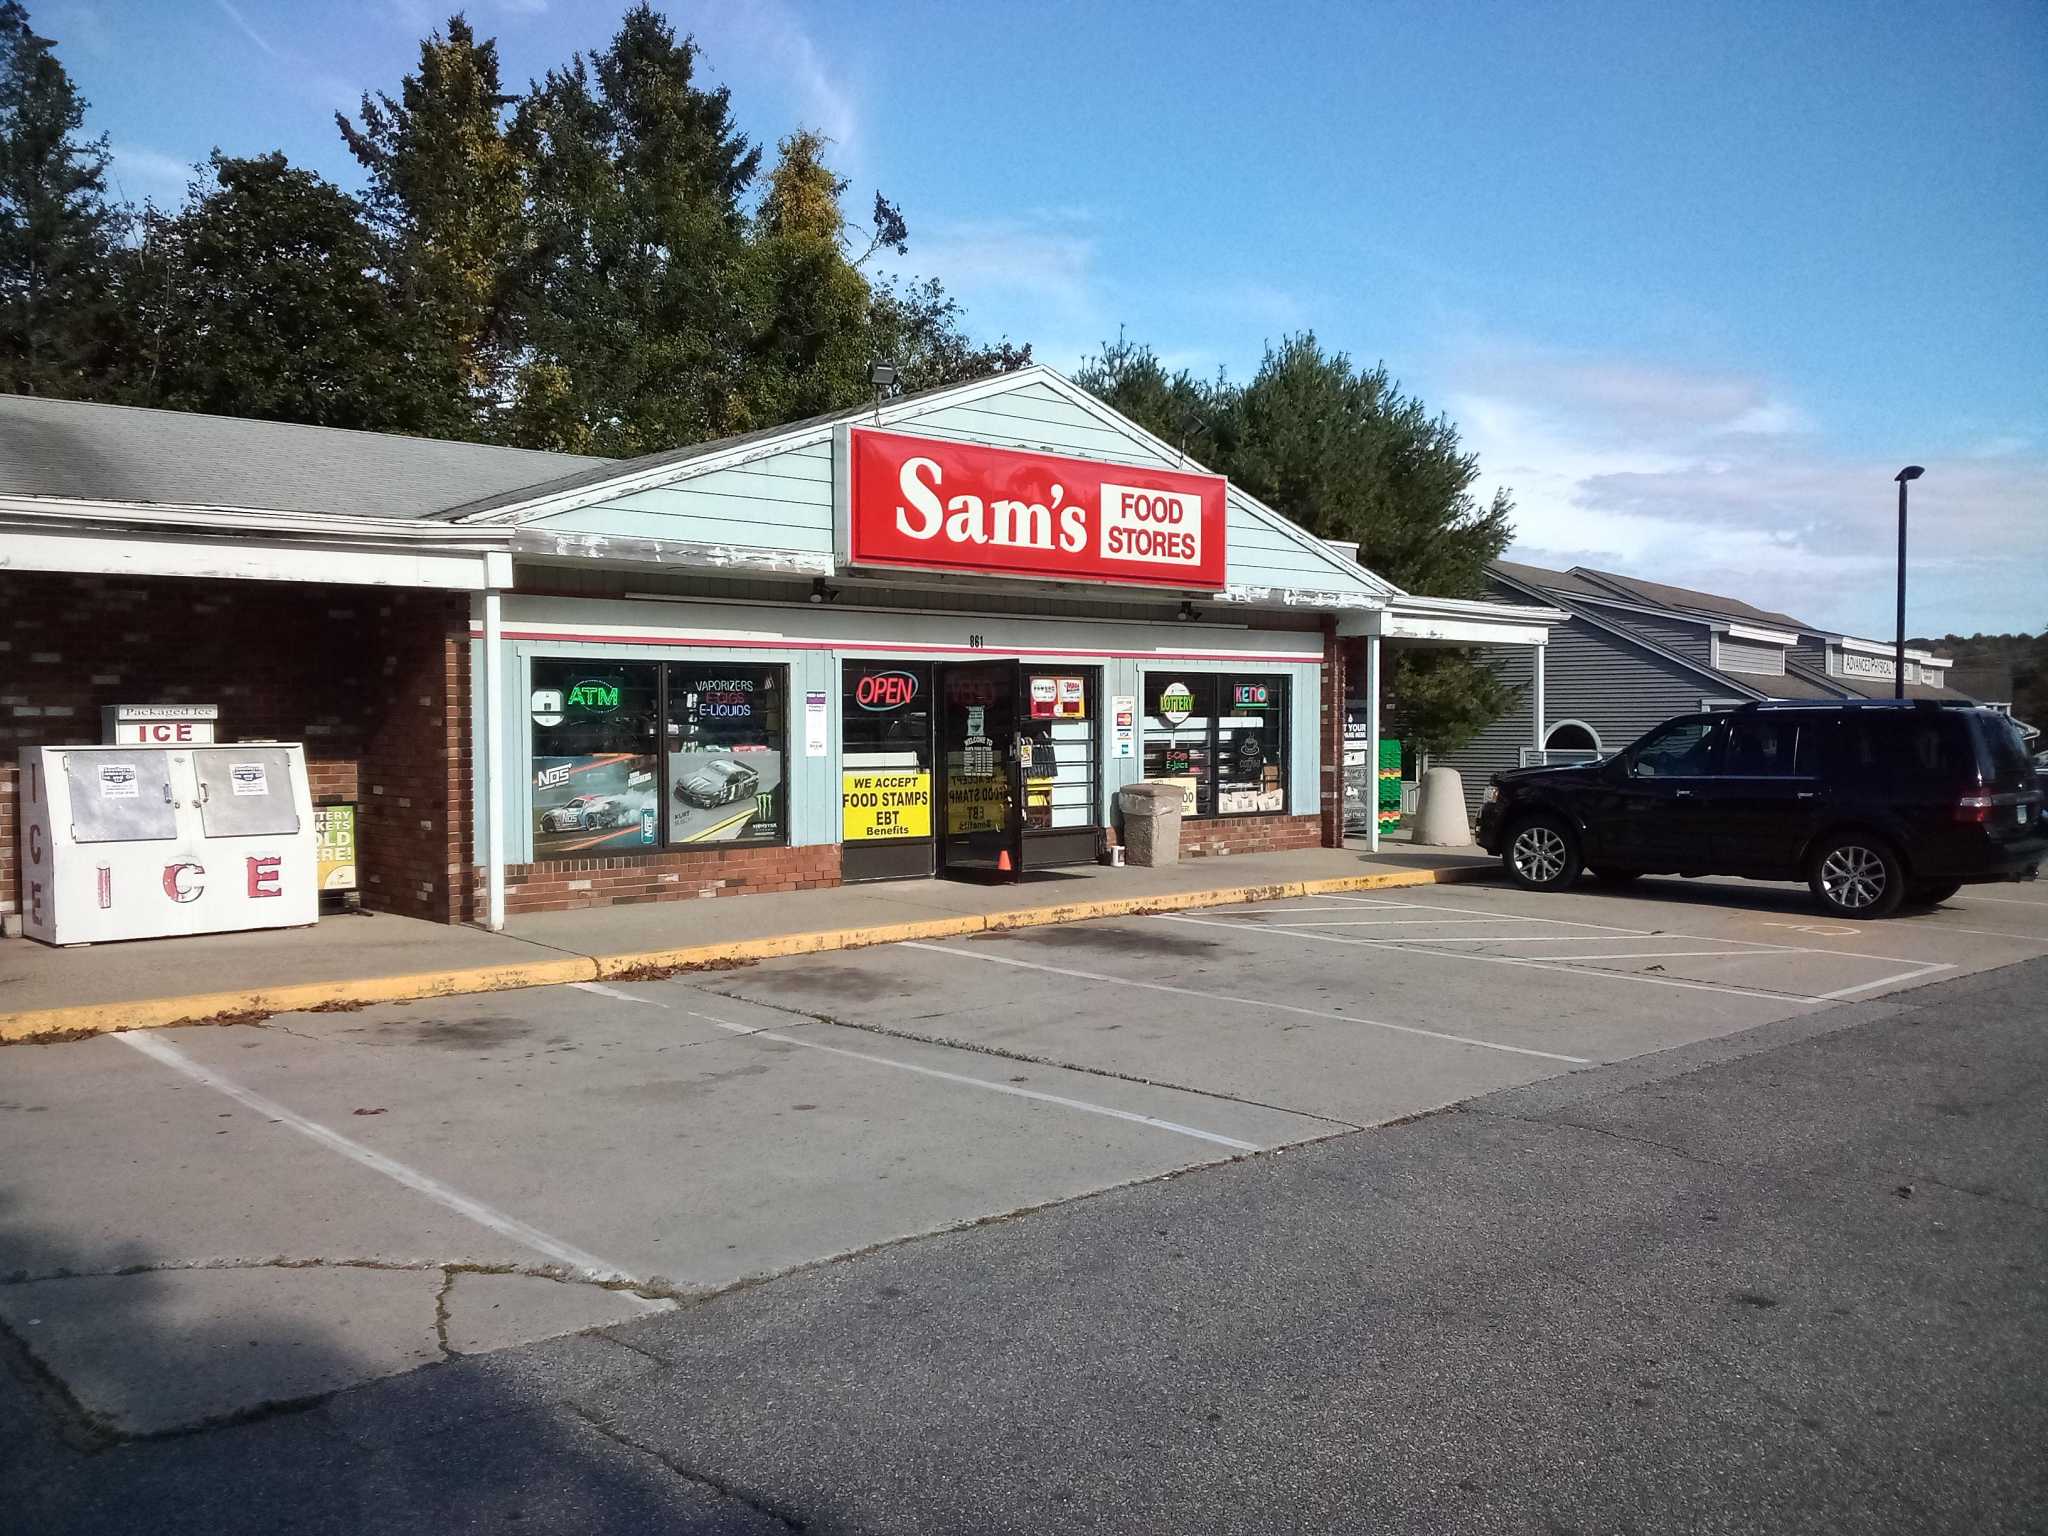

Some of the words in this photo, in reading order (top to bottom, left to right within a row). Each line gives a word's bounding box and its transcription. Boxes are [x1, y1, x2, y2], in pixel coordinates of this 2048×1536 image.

[896, 457, 1087, 553] Sam's
[1121, 493, 1184, 524] FOOD
[1108, 526, 1195, 560] STORES
[970, 635, 983, 648] 861
[695, 680, 753, 692] VAPORIZERS
[858, 676, 913, 704] OPEN
[568, 687, 618, 705] ATM
[1160, 695, 1192, 713] LOTTERY
[127, 708, 188, 718] Packaged
[194, 708, 212, 716] Ice
[700, 704, 751, 717] E-LIQUIDS
[139, 723, 192, 742] ICE
[538, 763, 572, 787] NOS
[854, 778, 871, 788] WE
[875, 777, 918, 788] ACCEPT
[842, 793, 878, 808] FOOD
[882, 791, 928, 807] STAMPS
[876, 811, 899, 825] EBT
[866, 826, 909, 836] Benefits
[30, 763, 42, 927] ICE
[97, 855, 282, 909] ICE
